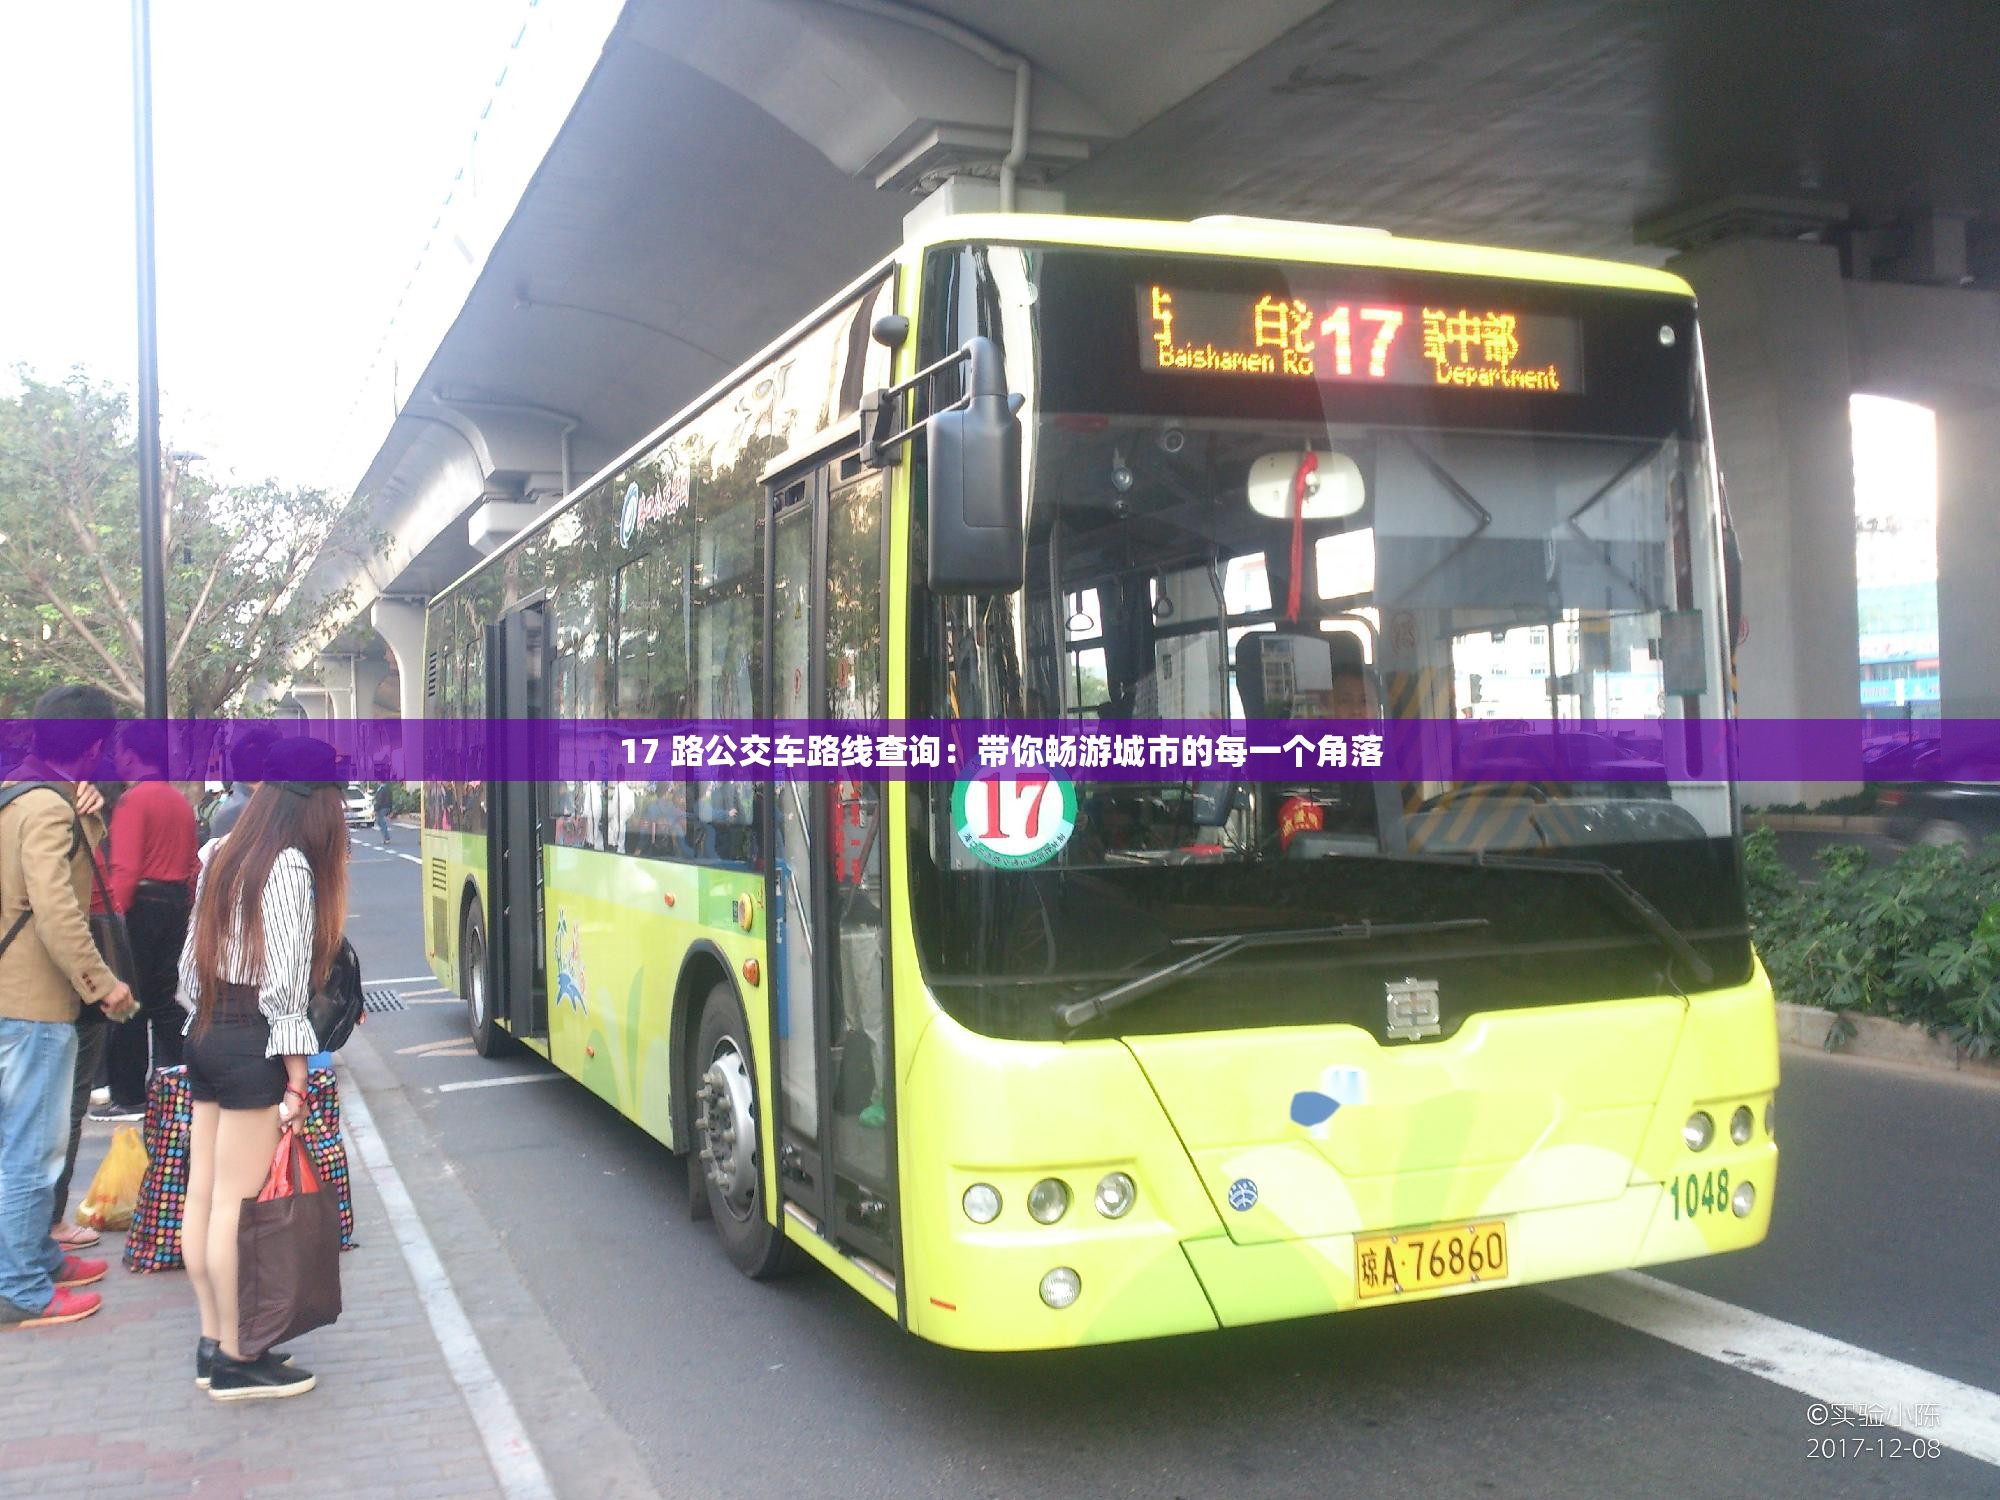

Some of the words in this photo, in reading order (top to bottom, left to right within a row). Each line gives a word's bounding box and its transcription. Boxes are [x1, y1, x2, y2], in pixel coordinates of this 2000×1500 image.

[1321, 306, 1403, 377] 17
[1436, 362, 1560, 390] Department
[978, 772, 1050, 839] 17
[1671, 1168, 1729, 1221] 1048
